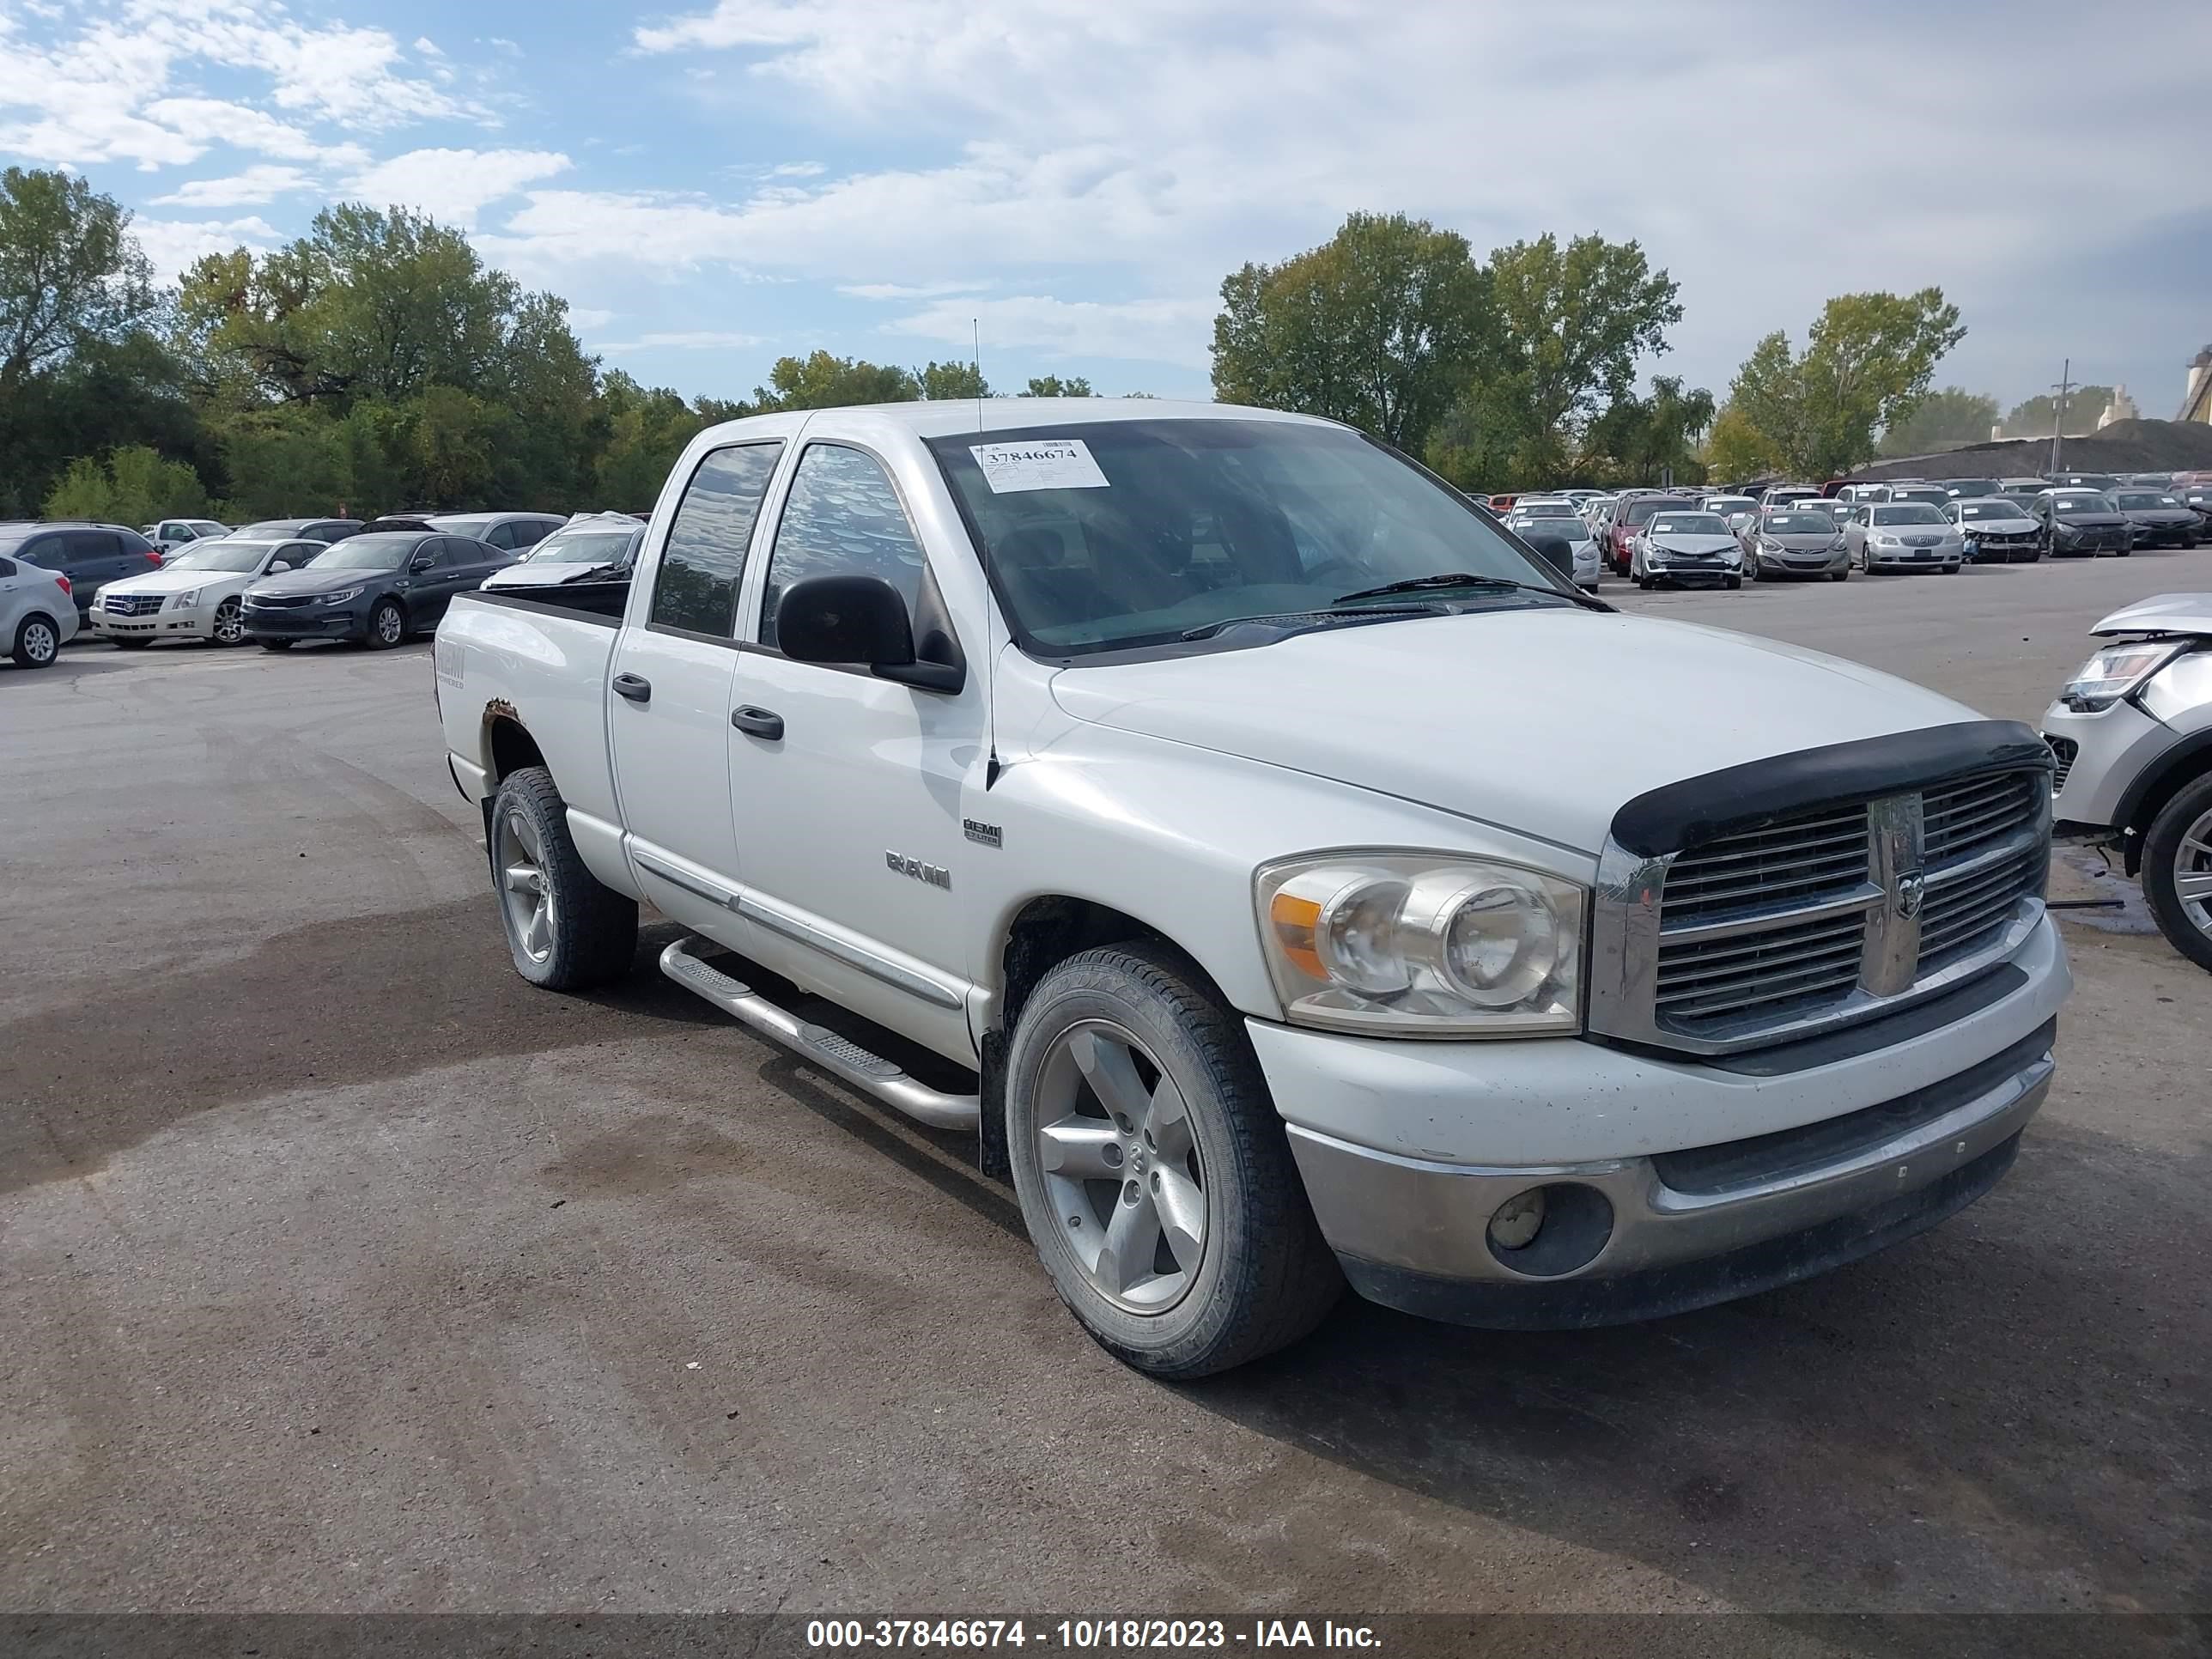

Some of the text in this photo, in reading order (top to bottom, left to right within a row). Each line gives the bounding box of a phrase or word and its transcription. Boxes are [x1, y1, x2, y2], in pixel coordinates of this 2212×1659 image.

[988, 449, 1078, 464] 37846674
[963, 818, 999, 836] HEMI
[977, 834, 998, 845] LITER
[885, 848, 951, 890] RAM
